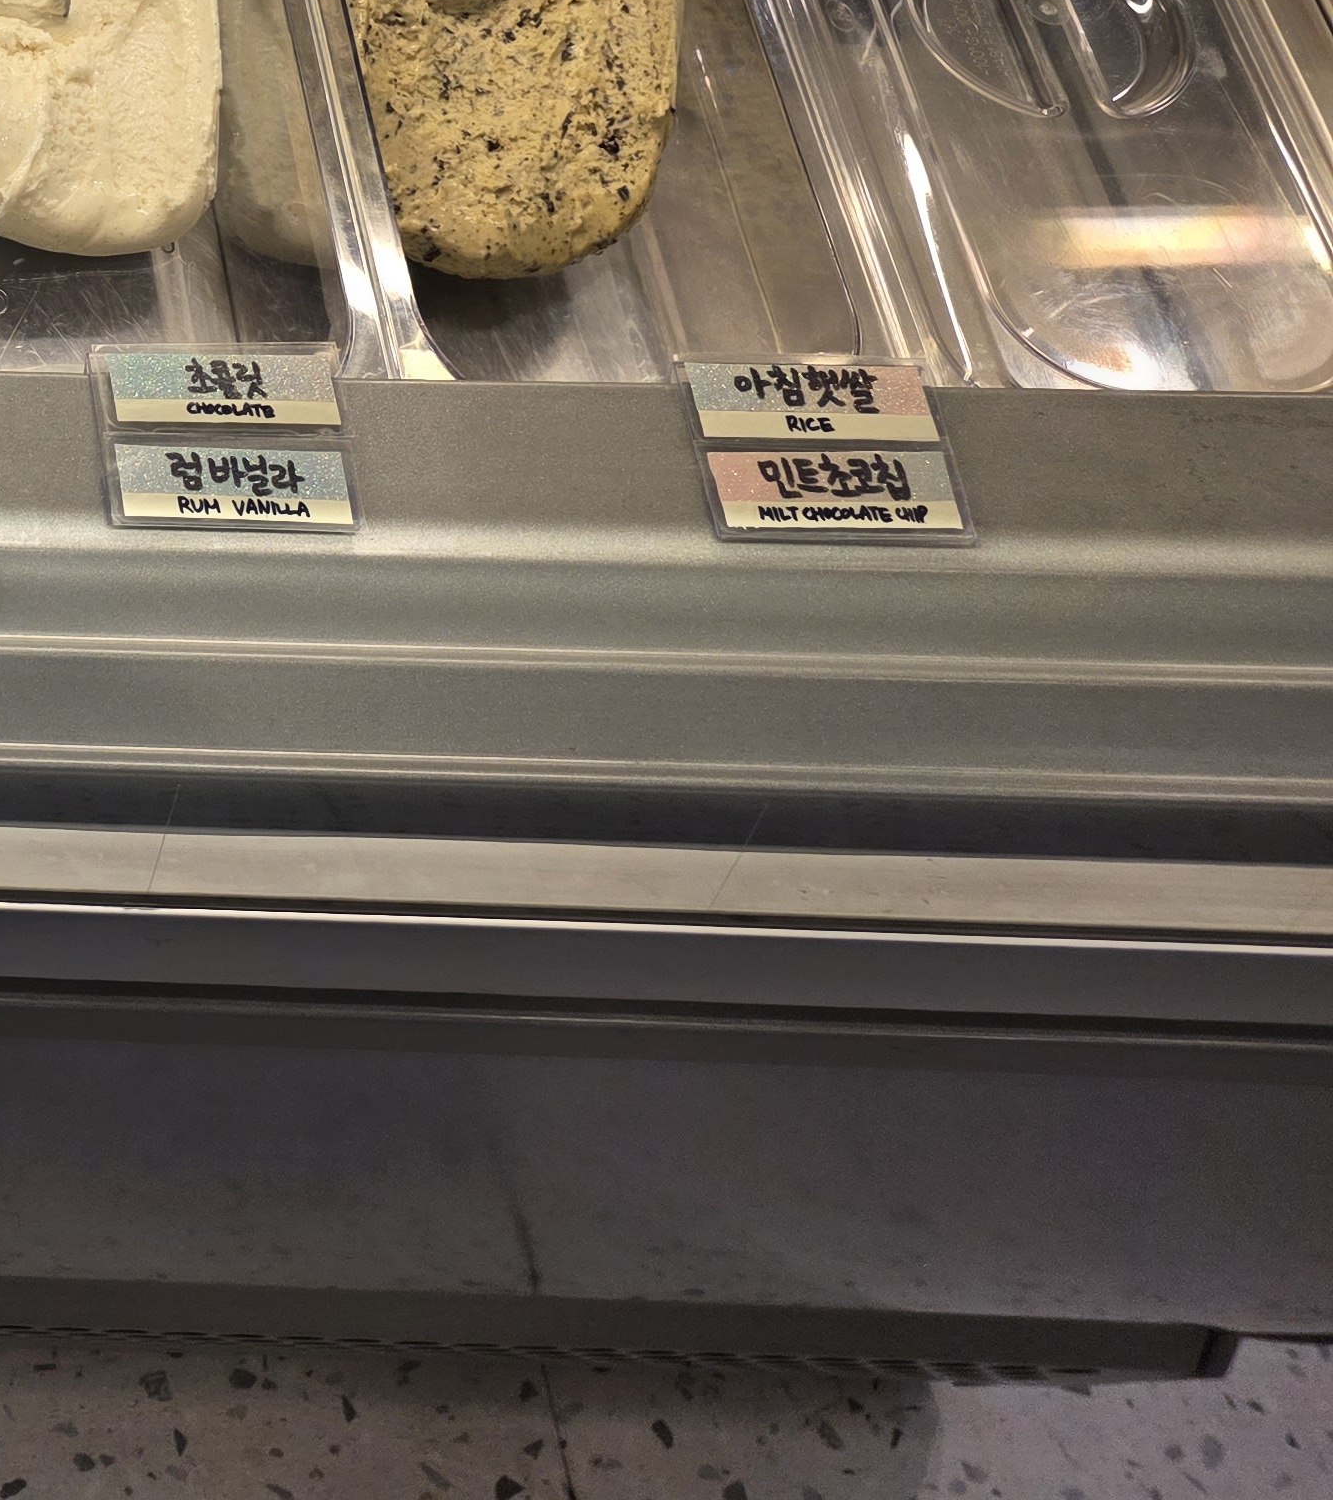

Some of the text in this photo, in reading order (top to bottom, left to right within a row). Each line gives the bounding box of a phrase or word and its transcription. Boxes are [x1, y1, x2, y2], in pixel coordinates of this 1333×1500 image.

[186, 401, 276, 419] CHOCOLATE
[785, 415, 835, 433] RICE
[757, 453, 912, 501] 민트초코칩
[177, 495, 311, 518] RUM VANILLA
[801, 505, 893, 523] CHOCOLATE
[895, 505, 929, 524] CHIP
